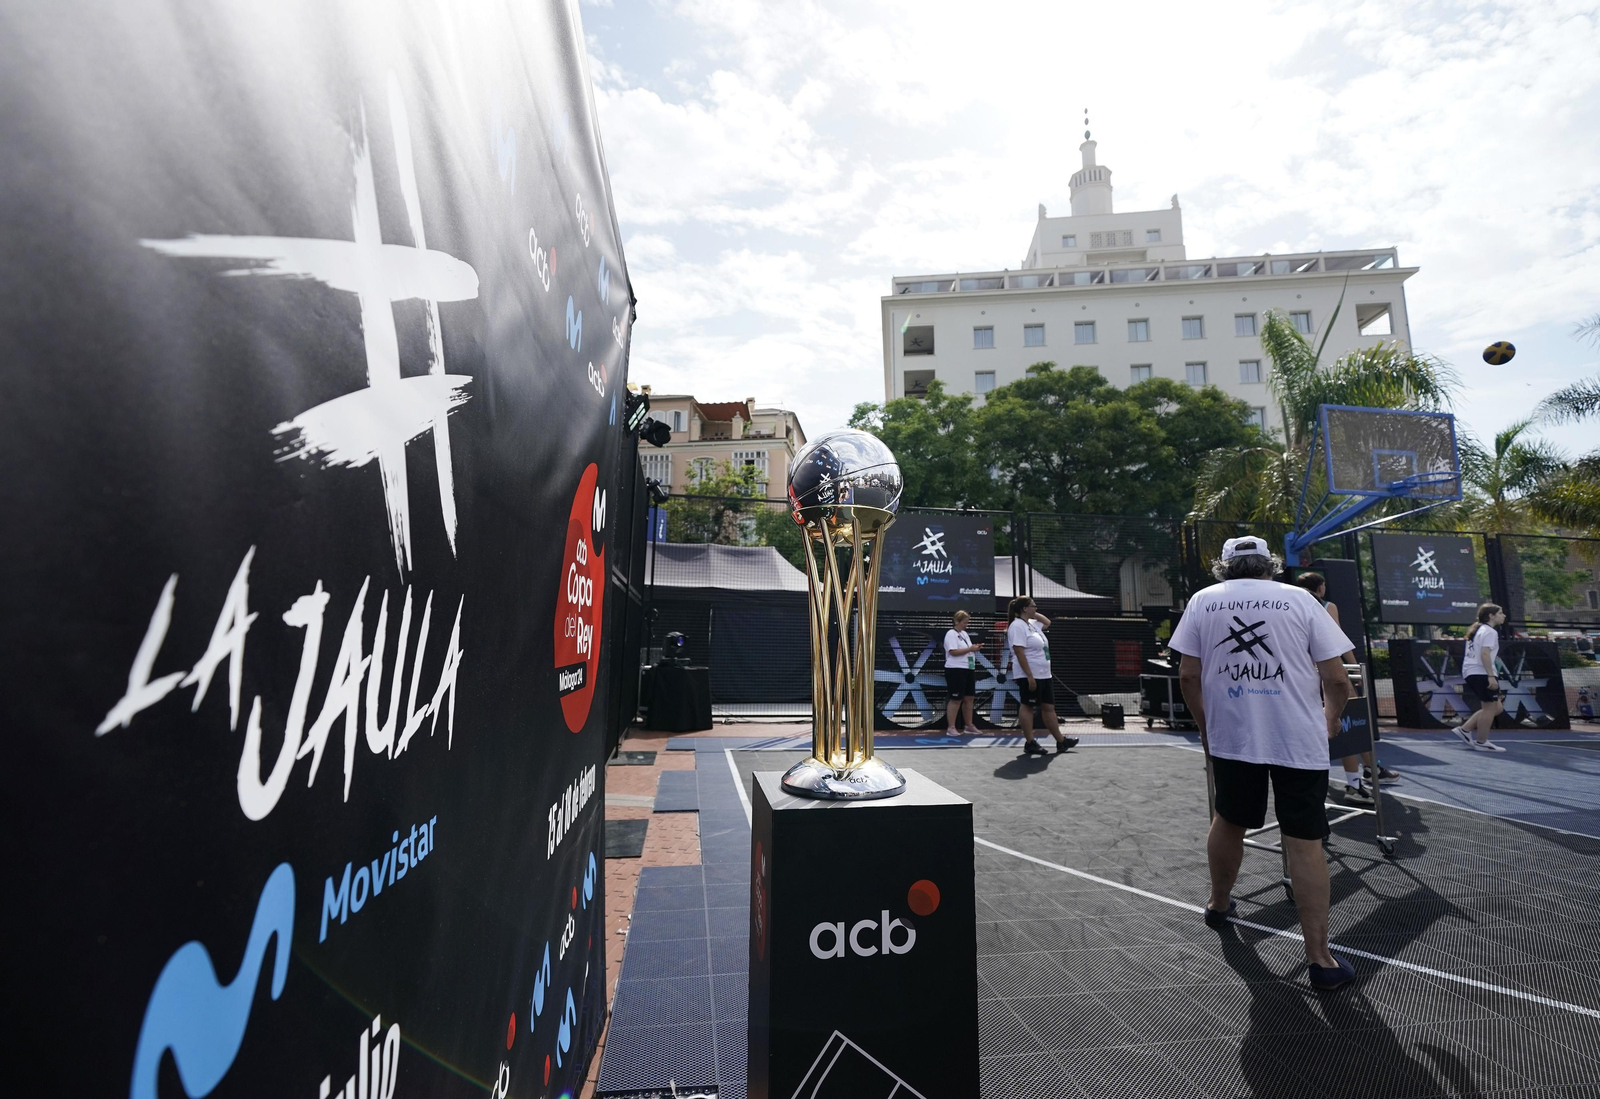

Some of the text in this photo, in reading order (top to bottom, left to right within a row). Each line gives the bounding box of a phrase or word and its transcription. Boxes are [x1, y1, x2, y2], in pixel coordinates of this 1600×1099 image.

[576, 193, 590, 247] acb
[529, 227, 550, 292] acb
[588, 361, 605, 398] acb
[576, 539, 587, 566] acb
[920, 561, 952, 575] JAULA
[567, 562, 593, 613] Copa
[1205, 600, 1290, 614] VOLUNTARIOS
[1418, 576, 1445, 590] JAULA
[565, 612, 594, 660] del Rey
[95, 545, 464, 822] LA JAULA
[1218, 662, 1285, 683] LA JAULA
[1247, 688, 1282, 696] Movistar
[547, 802, 558, 860] 15
[319, 815, 437, 944] Movistar
[559, 913, 575, 961] acb
[809, 909, 917, 960] acb
